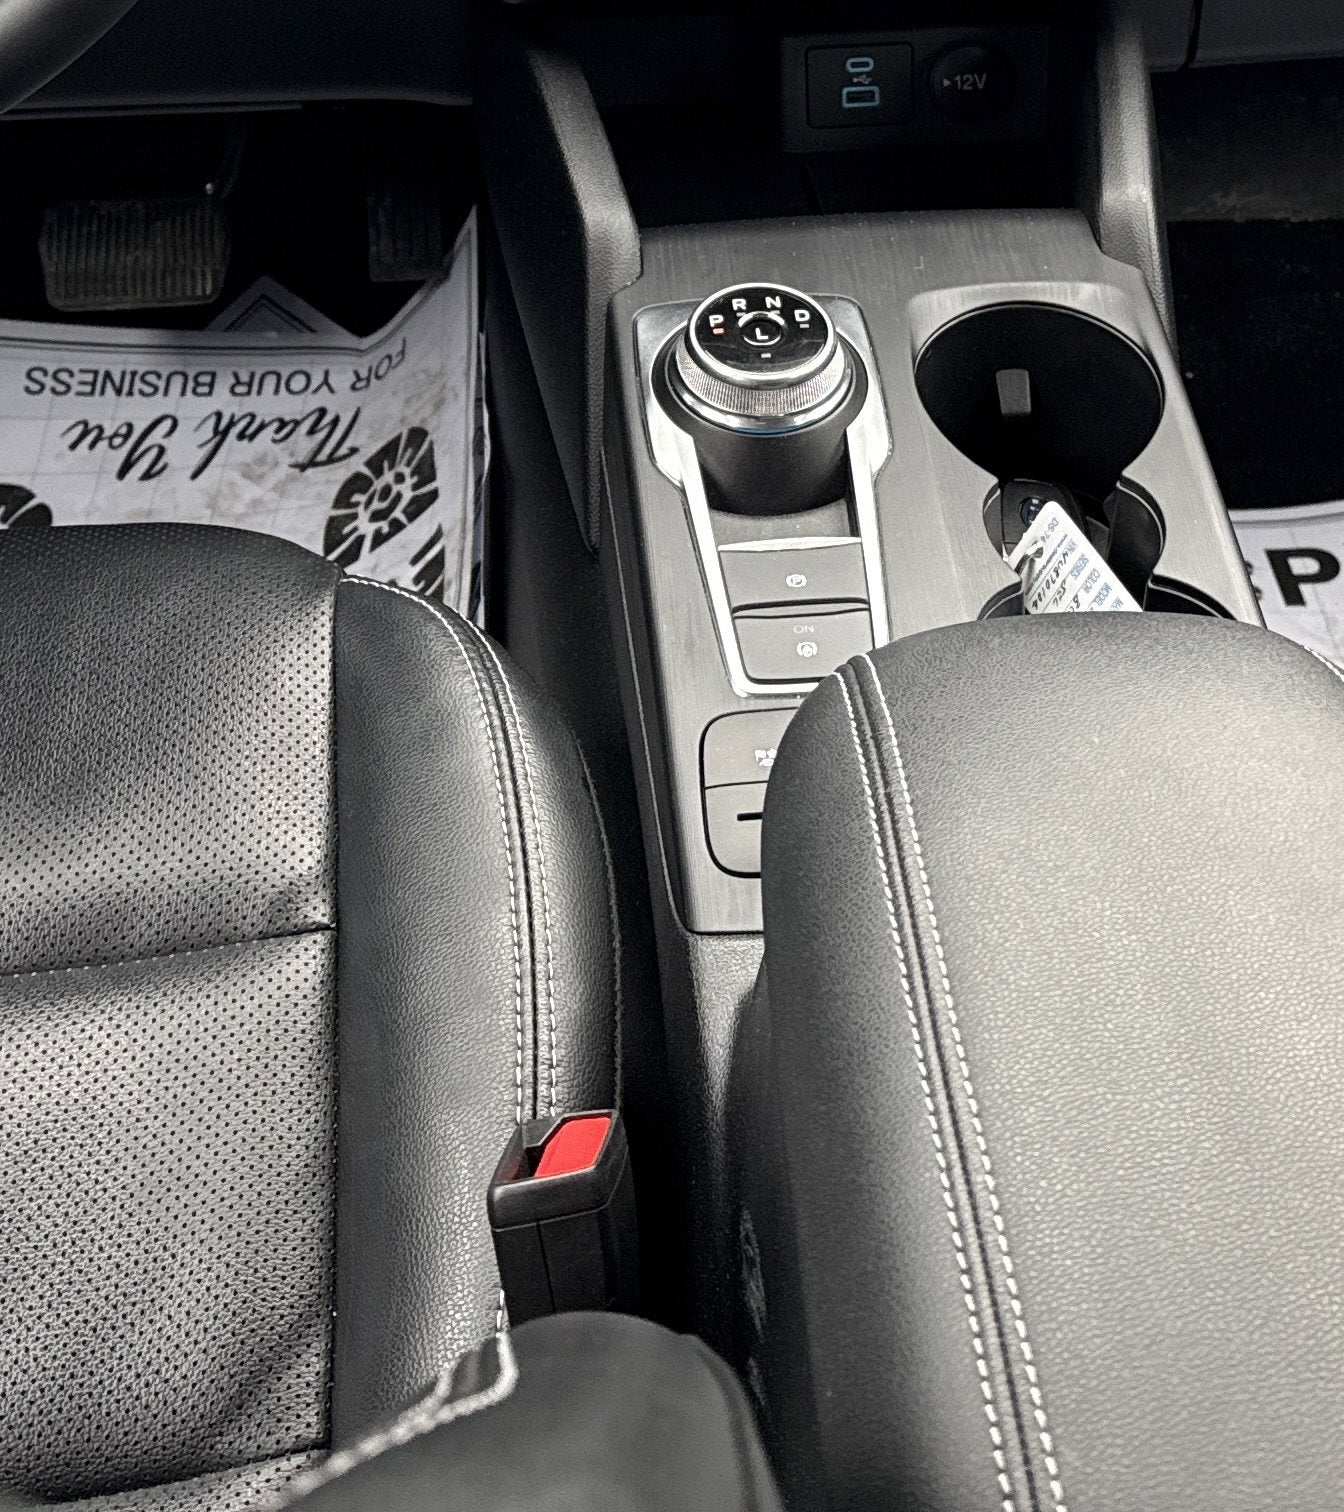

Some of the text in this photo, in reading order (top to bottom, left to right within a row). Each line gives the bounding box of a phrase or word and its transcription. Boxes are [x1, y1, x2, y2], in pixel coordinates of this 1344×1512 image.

[954, 72, 987, 90] 12V
[731, 298, 747, 311] R
[765, 296, 782, 309] N
[708, 314, 724, 328] P
[794, 309, 811, 322] D
[755, 327, 769, 340] L
[23, 337, 407, 398] FOR YOUR BUSINESS
[60, 406, 363, 483] Thank You
[793, 624, 815, 634] ON
